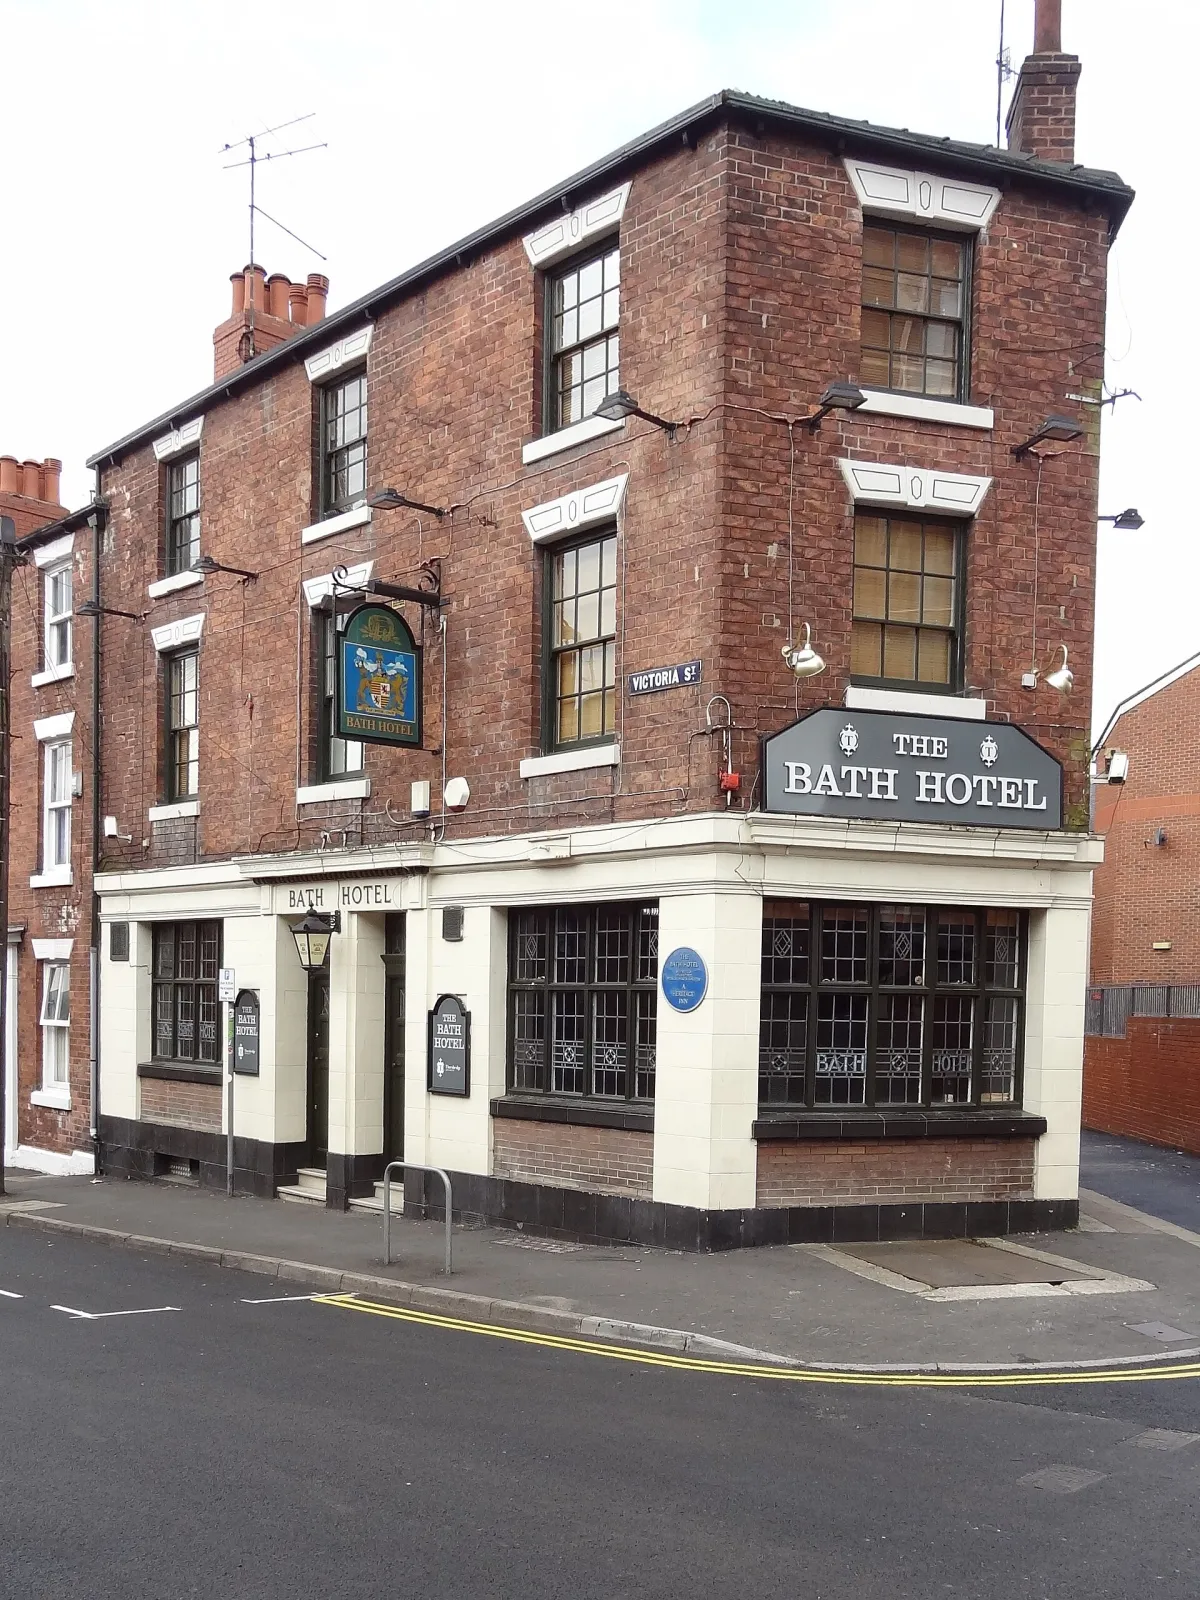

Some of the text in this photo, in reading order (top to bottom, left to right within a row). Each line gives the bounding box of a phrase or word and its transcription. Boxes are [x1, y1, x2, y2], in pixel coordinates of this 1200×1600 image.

[632, 669, 680, 691] VICTORIA
[346, 716, 414, 736] BATH HOTEL
[893, 733, 948, 758] THE
[783, 761, 1048, 810] BATH HOTEL
[289, 884, 392, 908] BATH HOTEL
[242, 1006, 253, 1014] THE
[442, 1013, 457, 1023] THE
[238, 1014, 256, 1025] BATH
[235, 1026, 259, 1036] HOTEL
[436, 1023, 462, 1036] BATH
[433, 1037, 465, 1050] HOTEL
[816, 1053, 866, 1073] BATH
